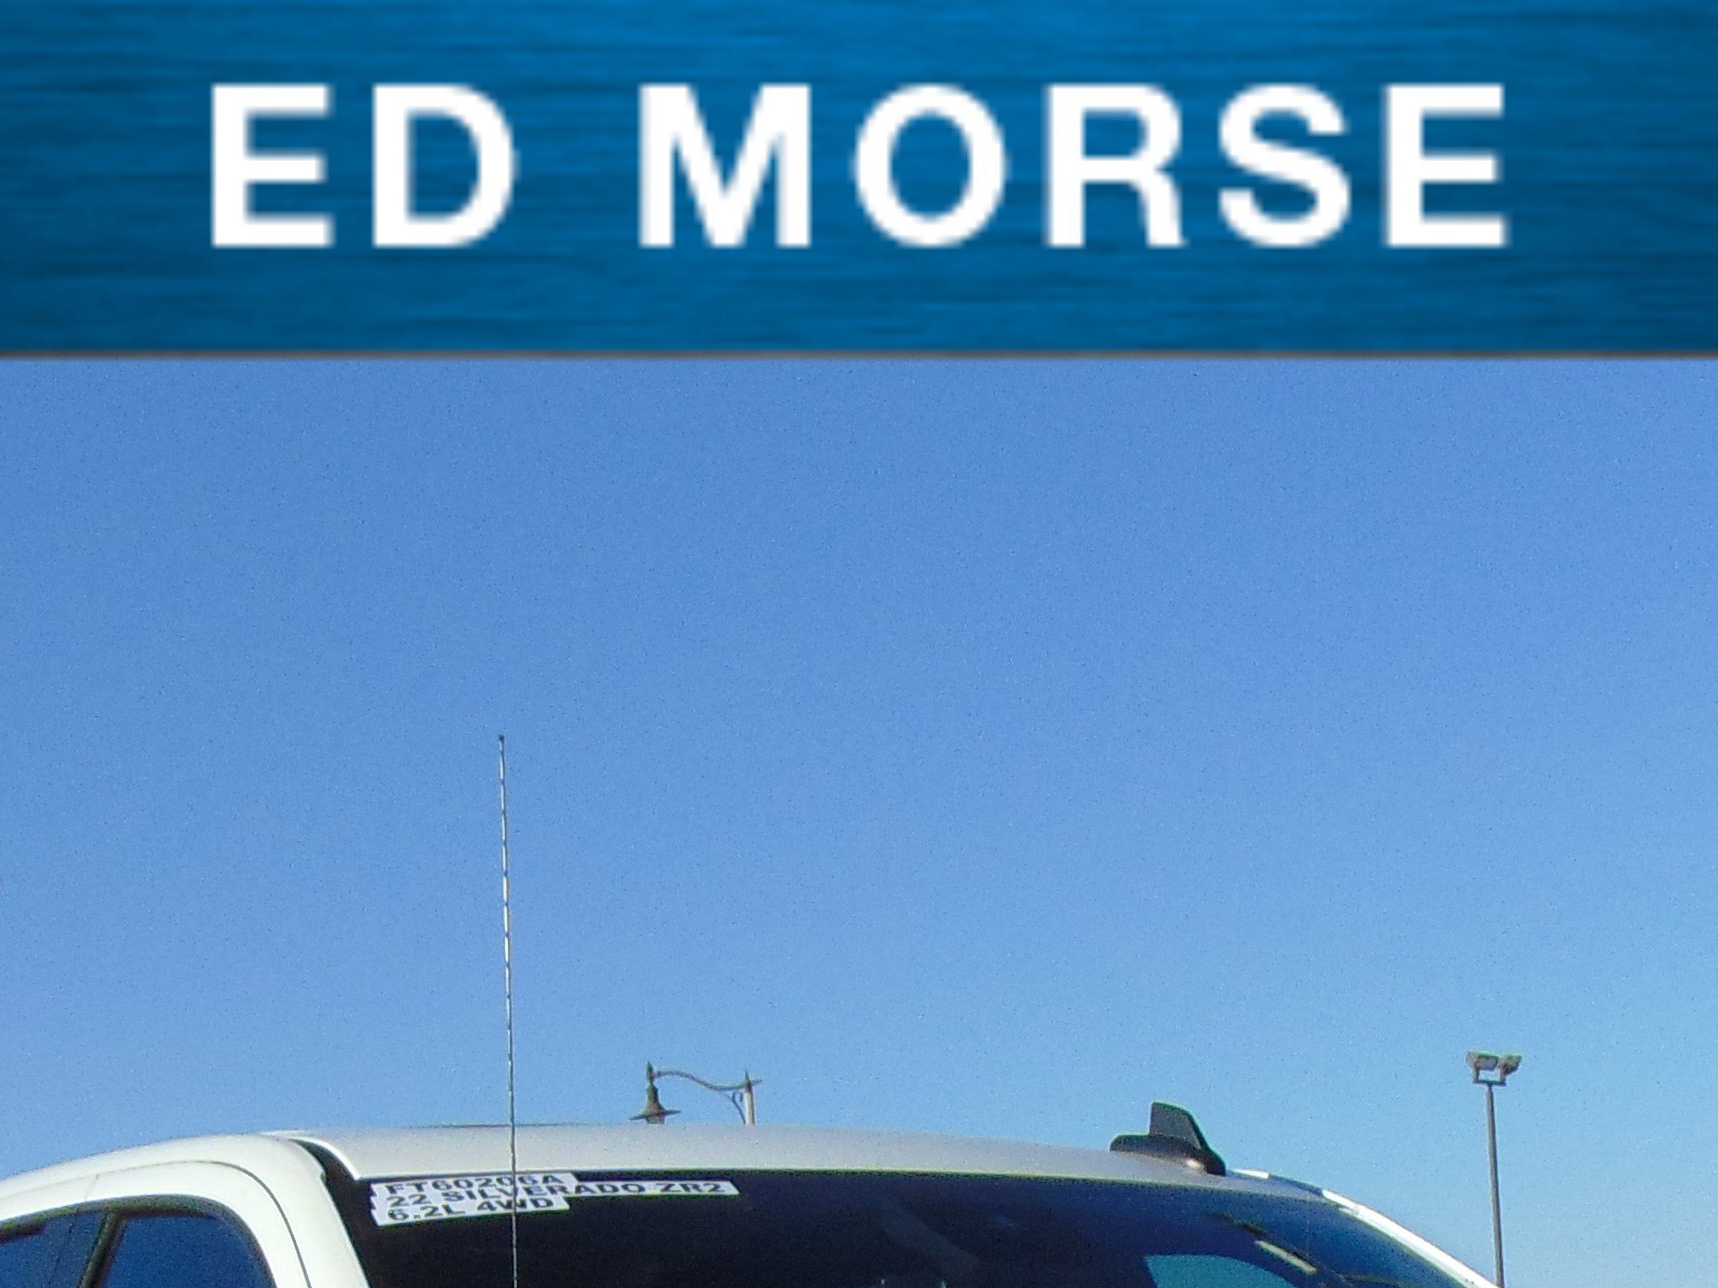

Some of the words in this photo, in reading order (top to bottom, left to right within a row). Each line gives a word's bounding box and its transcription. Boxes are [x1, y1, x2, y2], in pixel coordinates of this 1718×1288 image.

[386, 1194, 432, 1208] 22
[441, 1182, 646, 1203] SILVERADO
[656, 1183, 727, 1193] ZR2
[387, 1204, 466, 1221] 6.2L
[477, 1197, 554, 1213] 4WD
